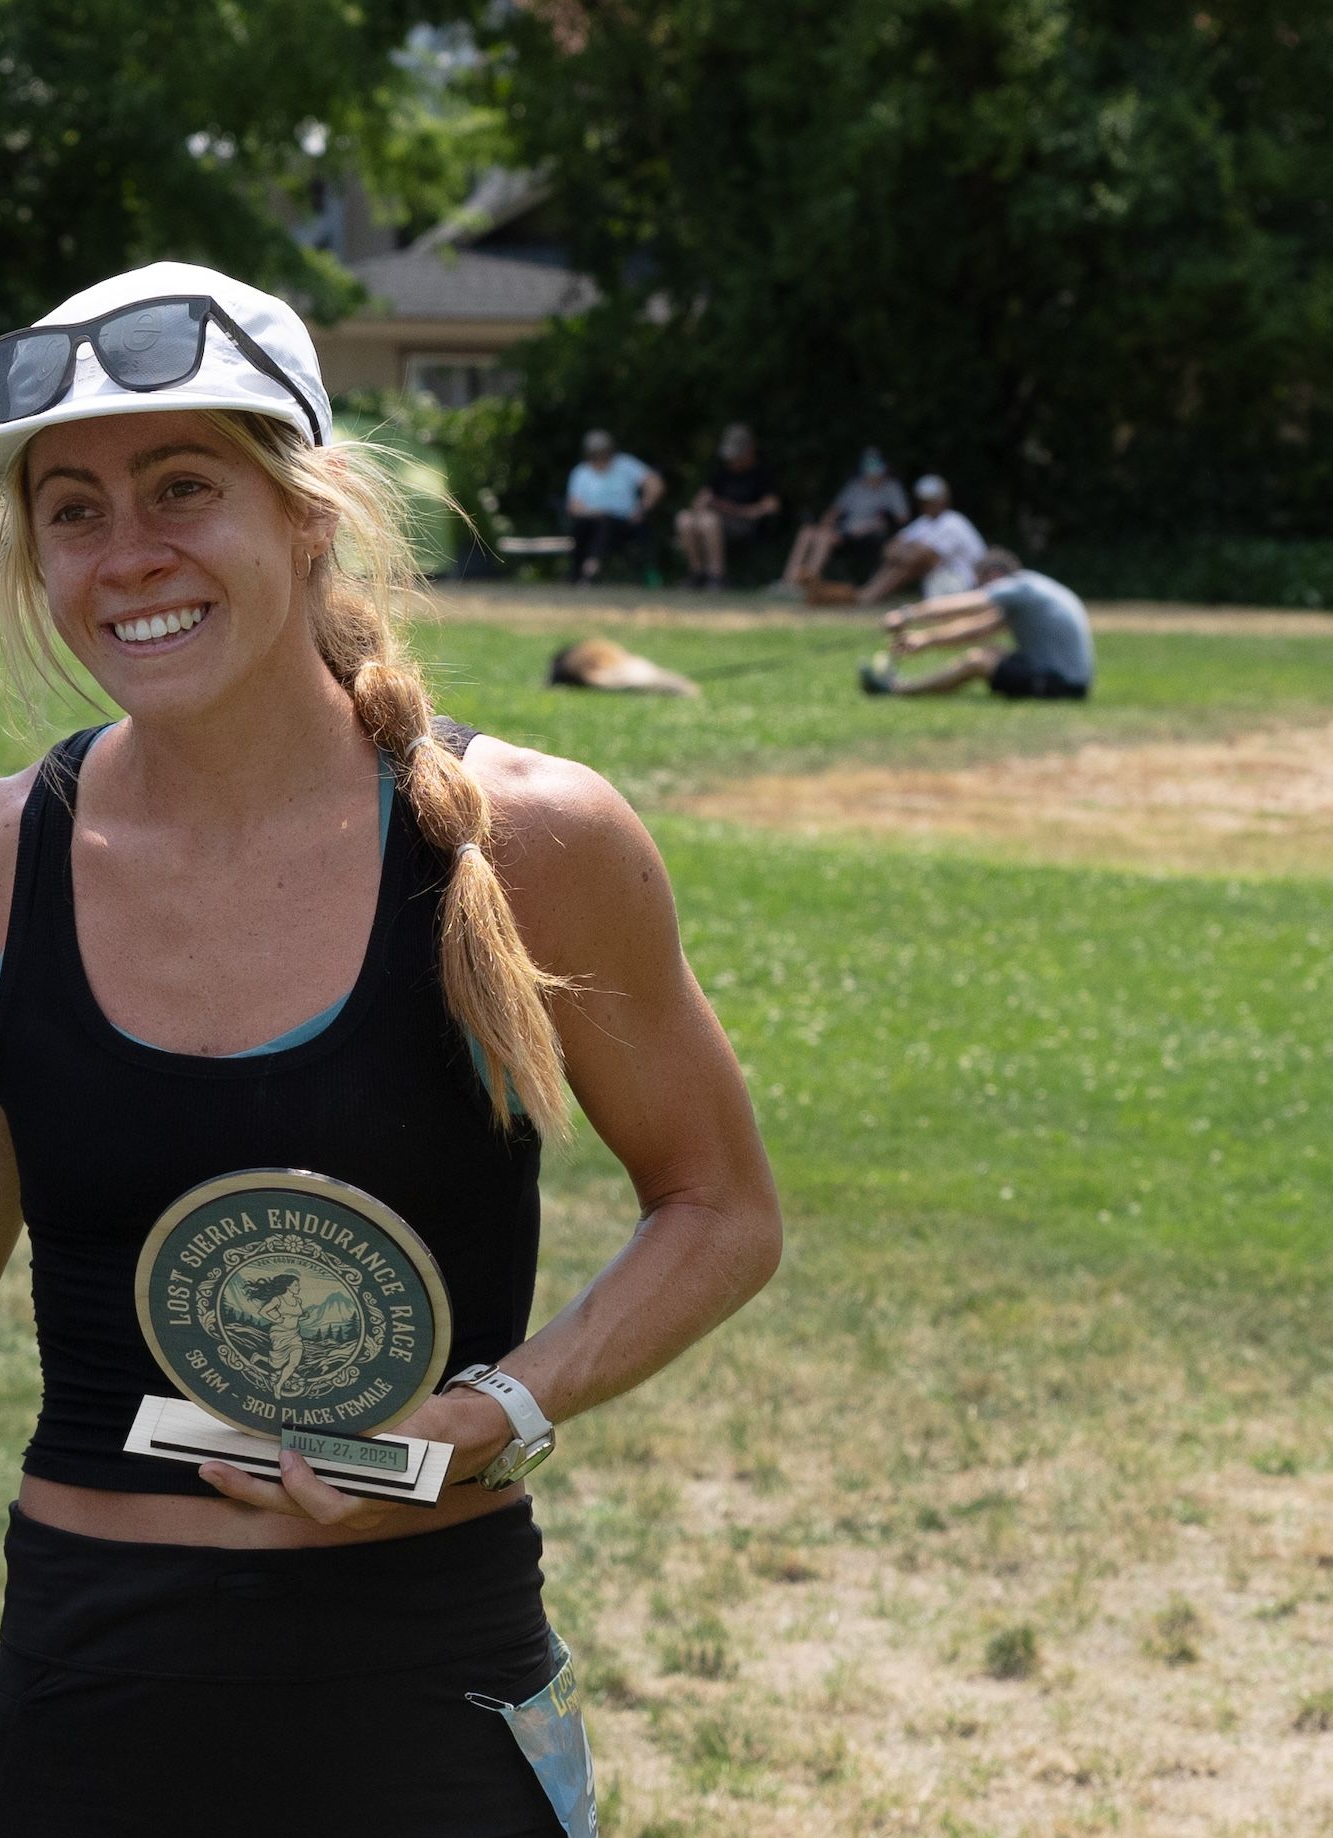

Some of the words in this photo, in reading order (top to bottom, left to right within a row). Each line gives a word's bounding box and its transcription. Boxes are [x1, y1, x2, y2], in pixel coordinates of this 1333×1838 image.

[167, 1270, 192, 1327] LOST
[180, 1212, 258, 1269] SIERRA
[267, 1208, 405, 1297] ENDURANCE
[389, 1304, 417, 1363] RACE
[200, 1368, 230, 1394] KM
[242, 1395, 277, 1420] 3RD
[281, 1407, 335, 1425] PLACE
[335, 1377, 394, 1420] FEMALE
[289, 1435, 326, 1454] JULY
[333, 1442, 353, 1460] 27,
[360, 1447, 398, 1466] 2024
